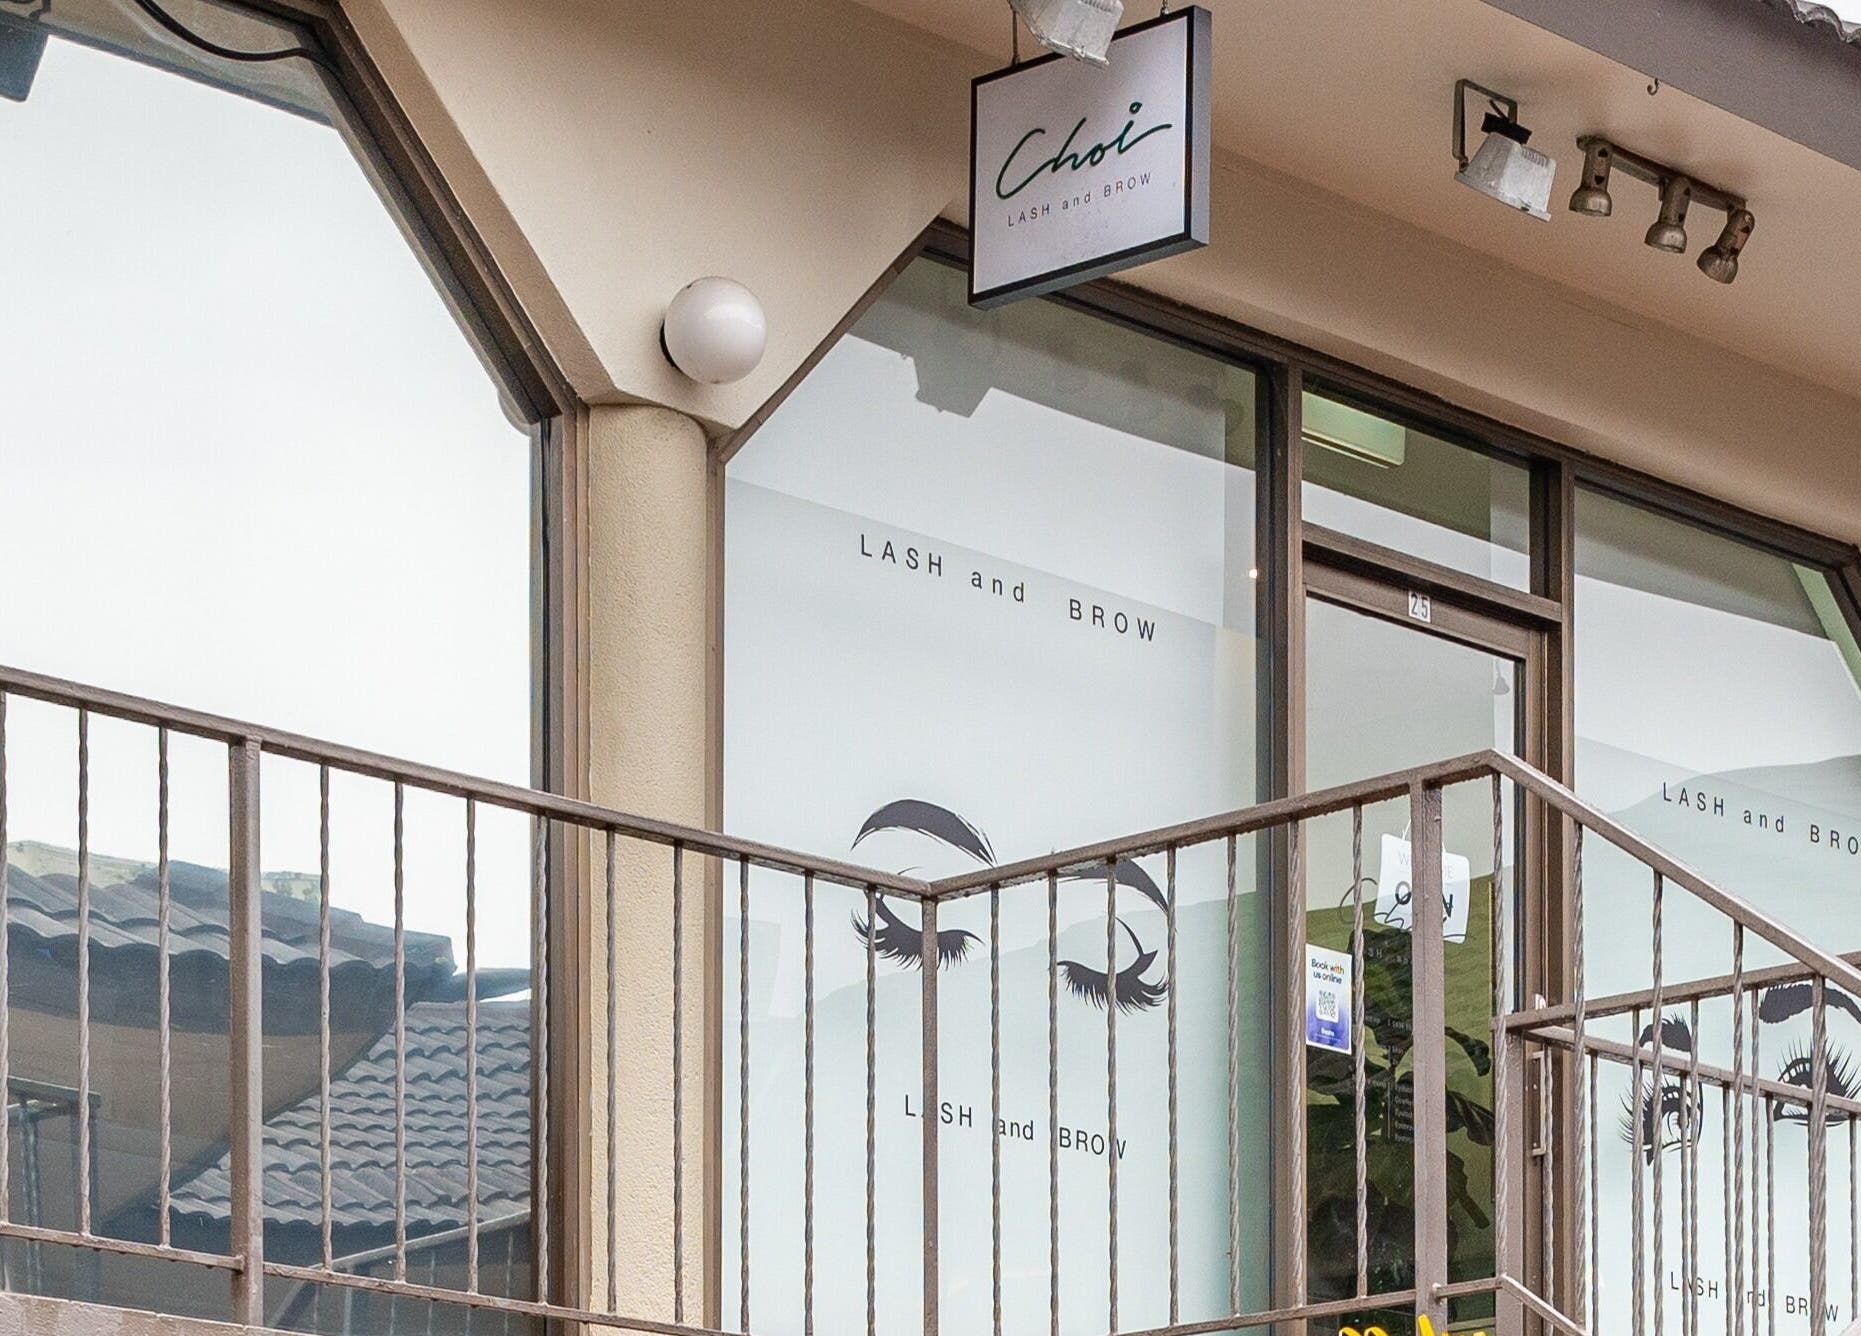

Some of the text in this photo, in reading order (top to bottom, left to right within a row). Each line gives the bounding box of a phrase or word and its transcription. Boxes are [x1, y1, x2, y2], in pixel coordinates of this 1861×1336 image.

[995, 101, 1173, 200] Choi
[1007, 173, 1152, 228] LASH and BROW
[860, 533, 1156, 642] LASH and BROW
[1410, 592, 1429, 619] 25
[1662, 782, 1725, 817] LASH
[1743, 809, 1785, 833] and
[904, 1094, 973, 1127] LSH
[997, 1118, 1034, 1141] and
[1785, 1295, 1839, 1322] BRW
